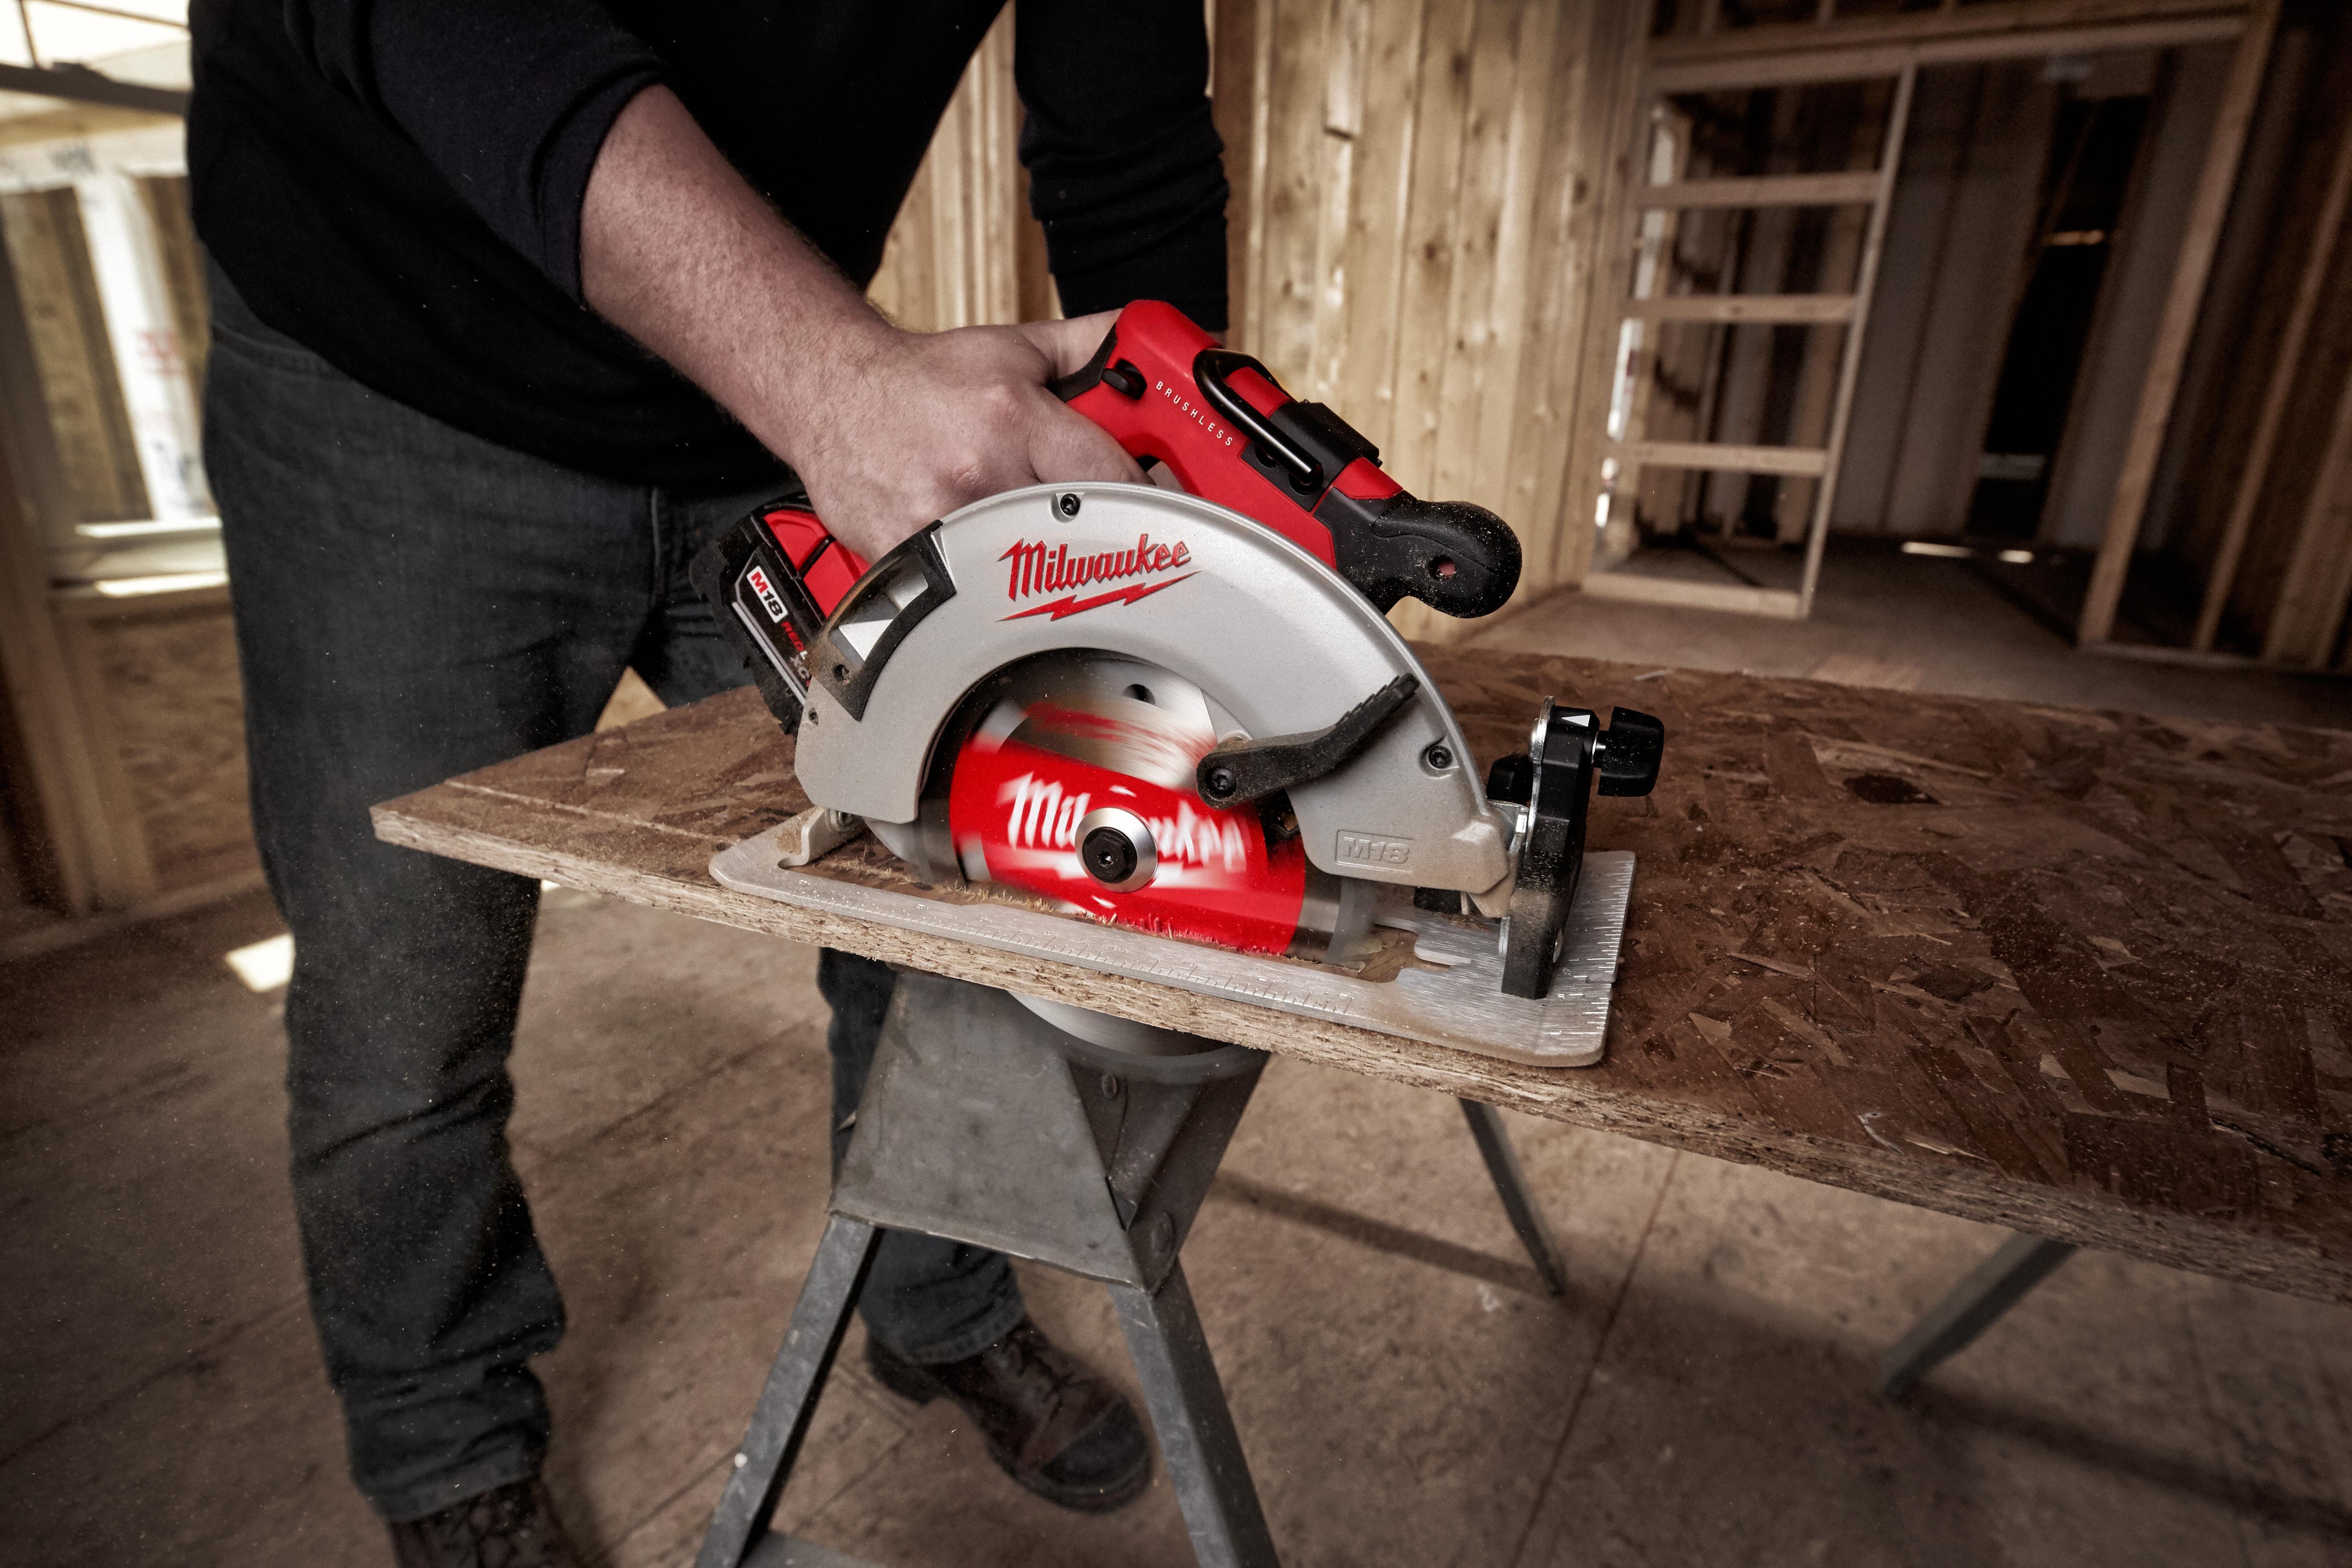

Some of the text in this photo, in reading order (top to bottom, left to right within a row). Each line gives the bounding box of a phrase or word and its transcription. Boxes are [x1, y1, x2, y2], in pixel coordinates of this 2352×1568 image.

[1156, 381, 1233, 446] BRUSHLESS
[751, 571, 784, 616] M18
[997, 533, 1192, 602] Milwaukee
[1343, 836, 1410, 864] M18
